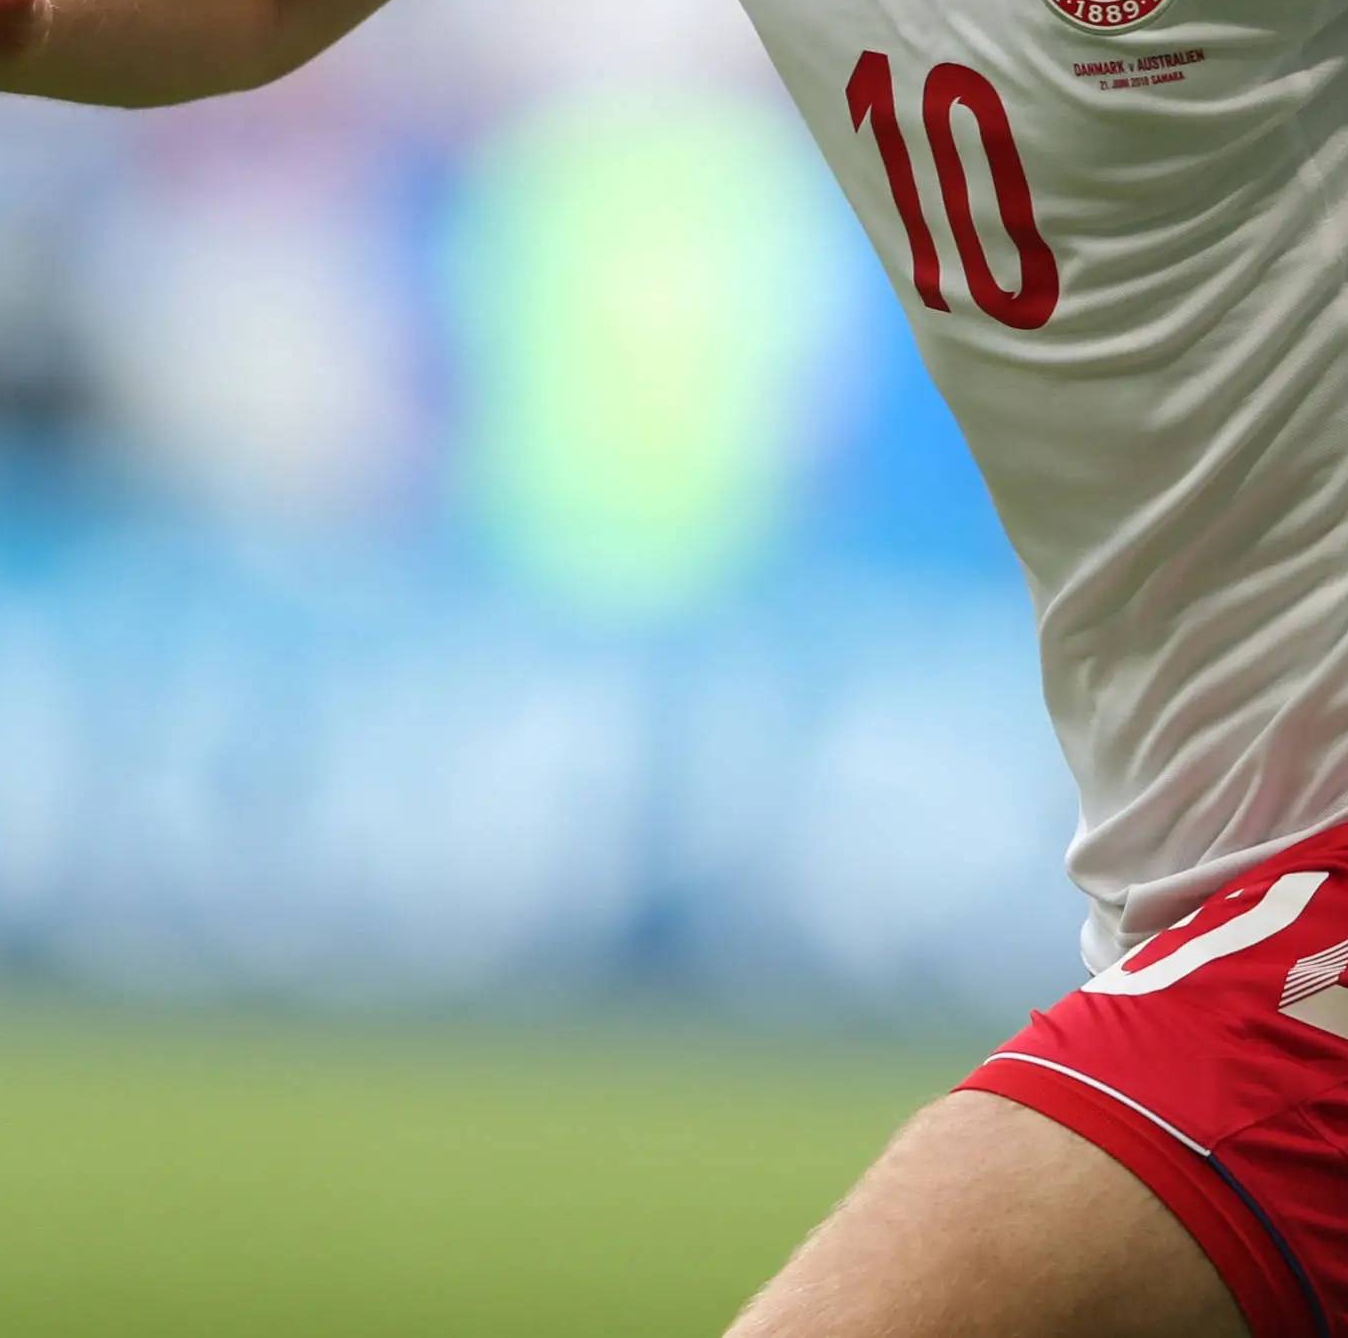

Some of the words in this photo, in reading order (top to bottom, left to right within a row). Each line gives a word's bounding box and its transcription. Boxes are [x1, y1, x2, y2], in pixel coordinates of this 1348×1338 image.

[1073, 0, 1140, 24] 1889
[1073, 60, 1125, 77] DANMARK
[1137, 48, 1205, 72] AUSTRALIEN
[846, 50, 1060, 330] 10
